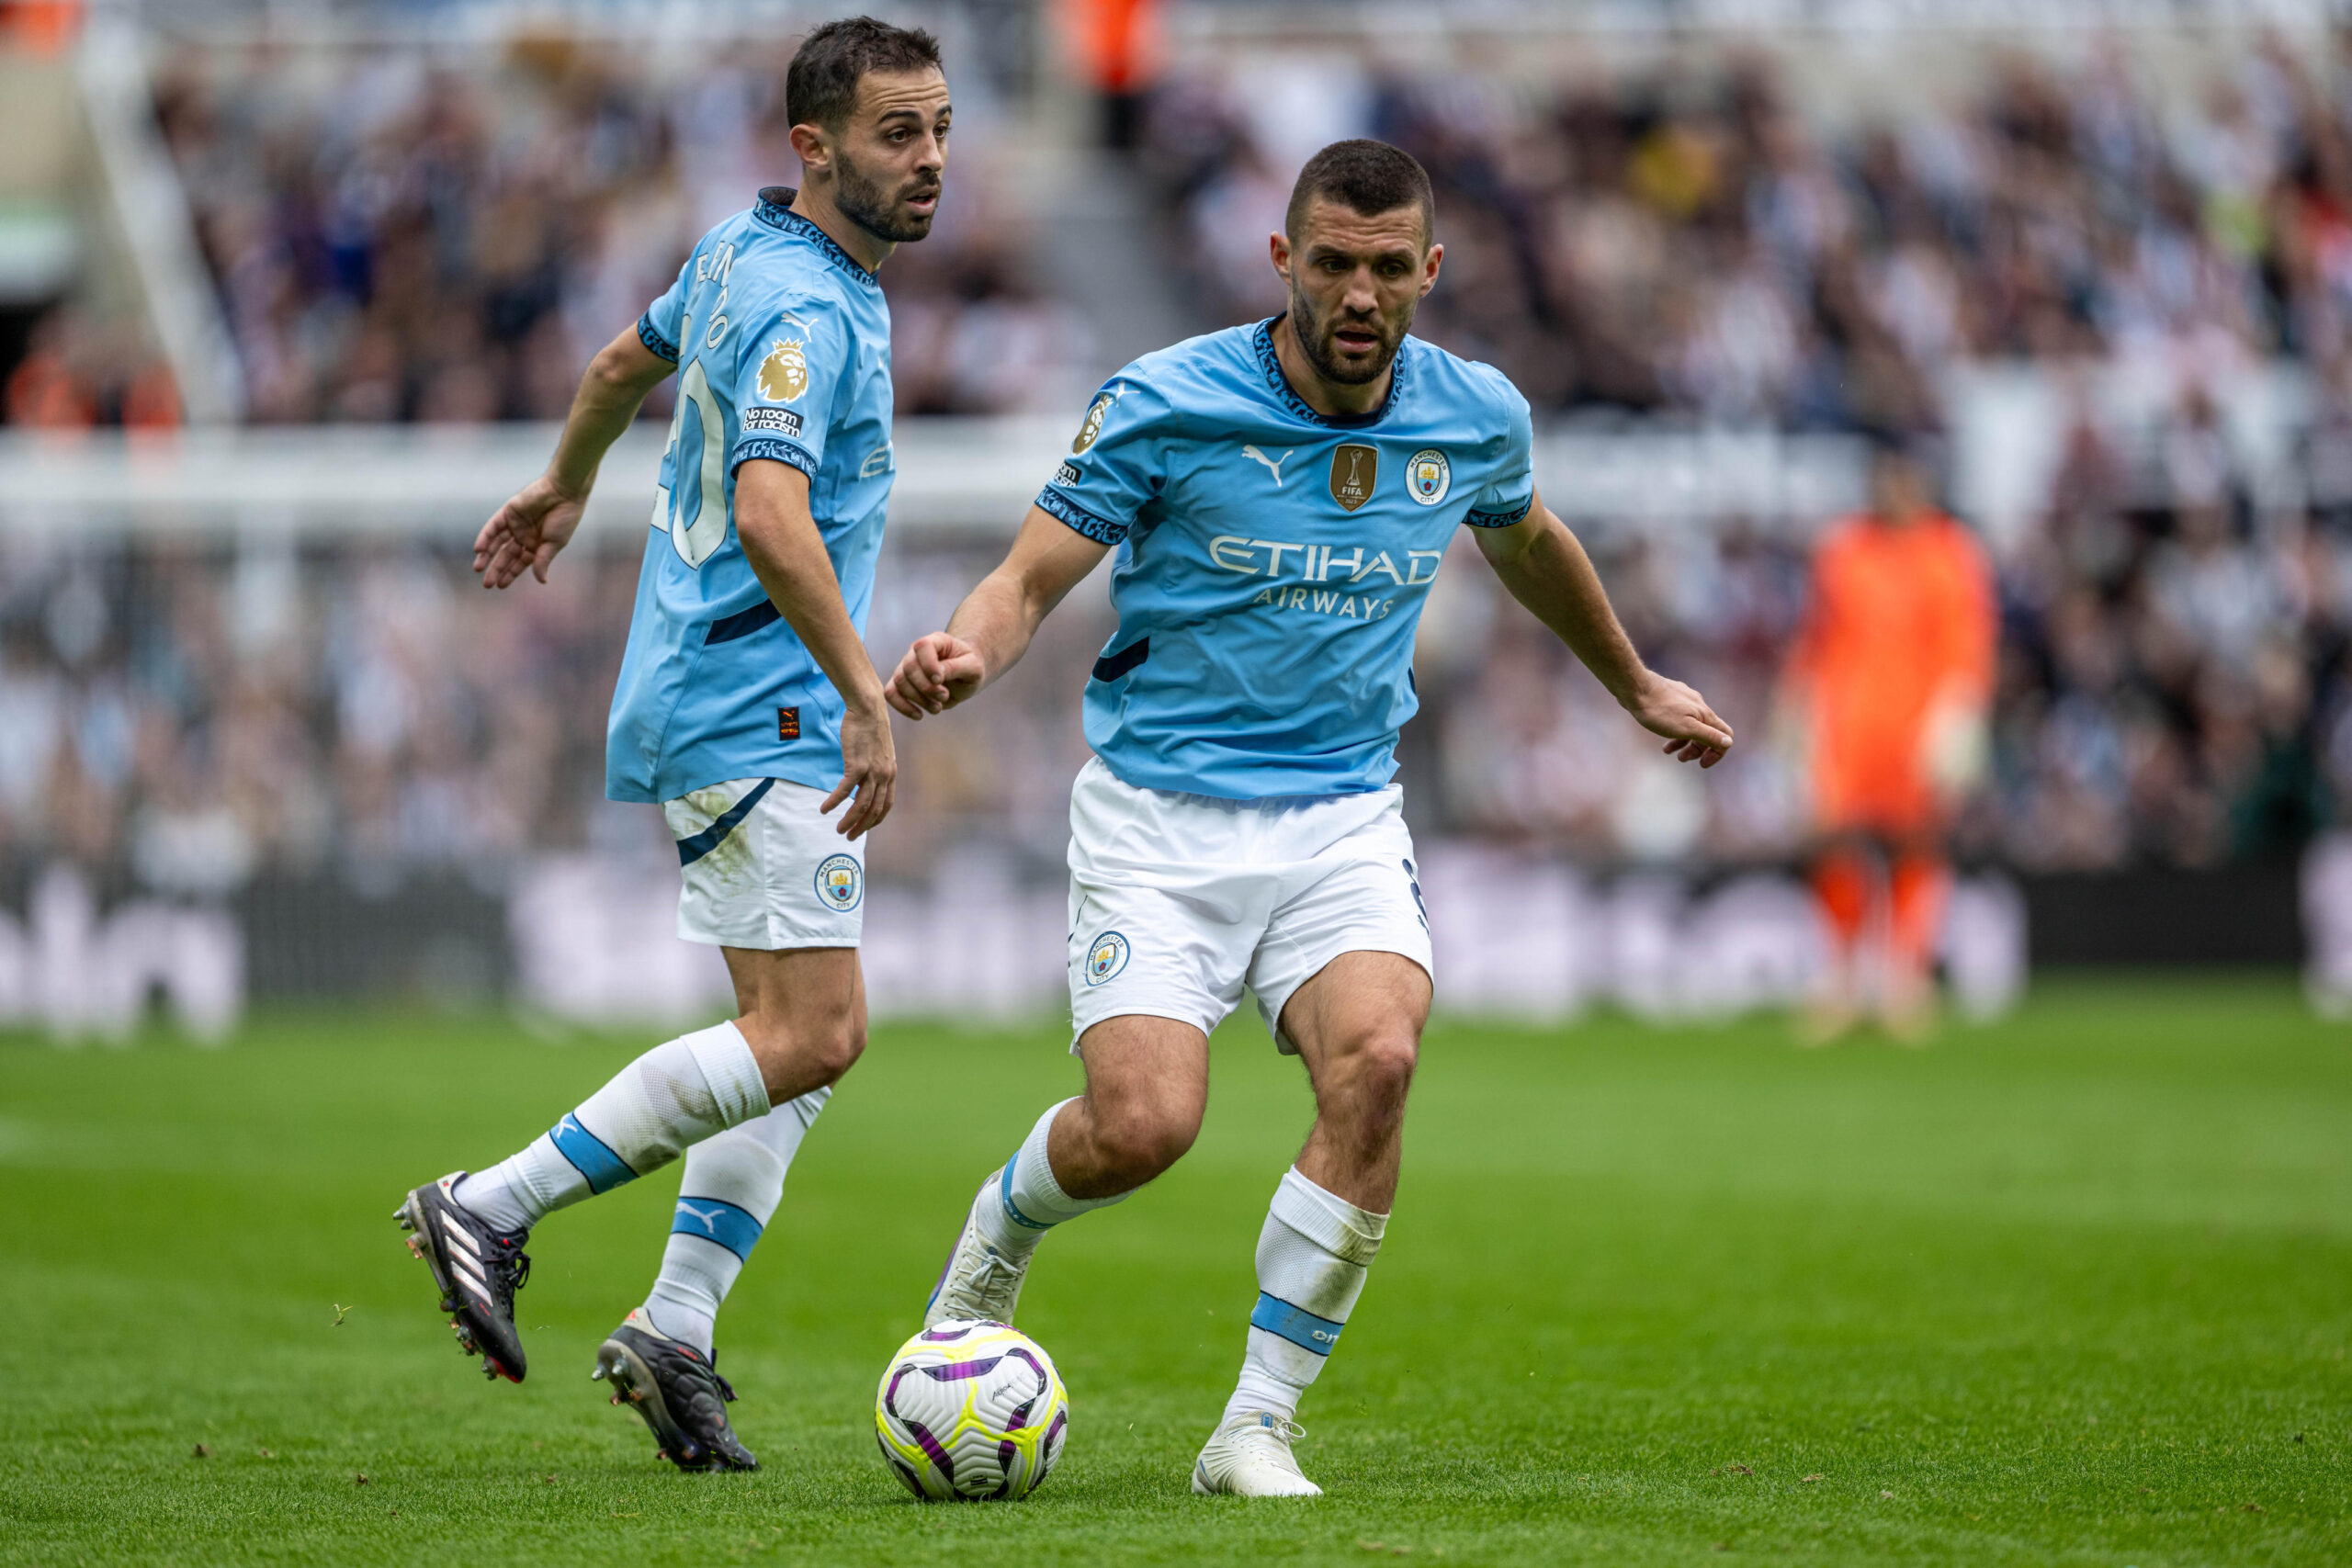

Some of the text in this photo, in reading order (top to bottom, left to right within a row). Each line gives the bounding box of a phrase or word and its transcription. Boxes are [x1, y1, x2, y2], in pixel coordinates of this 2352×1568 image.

[744, 408, 797, 426] No room
[742, 419, 800, 438] for racism
[1410, 450, 1447, 471] MANCHESTER
[1342, 486, 1363, 496] FIFA
[1419, 496, 1435, 504] CITY
[1209, 536, 1442, 586] ETIHAD
[1253, 585, 1396, 621] AIRWAYS
[820, 859, 858, 877] MANCHESTER
[1096, 973, 1110, 984] CITY
